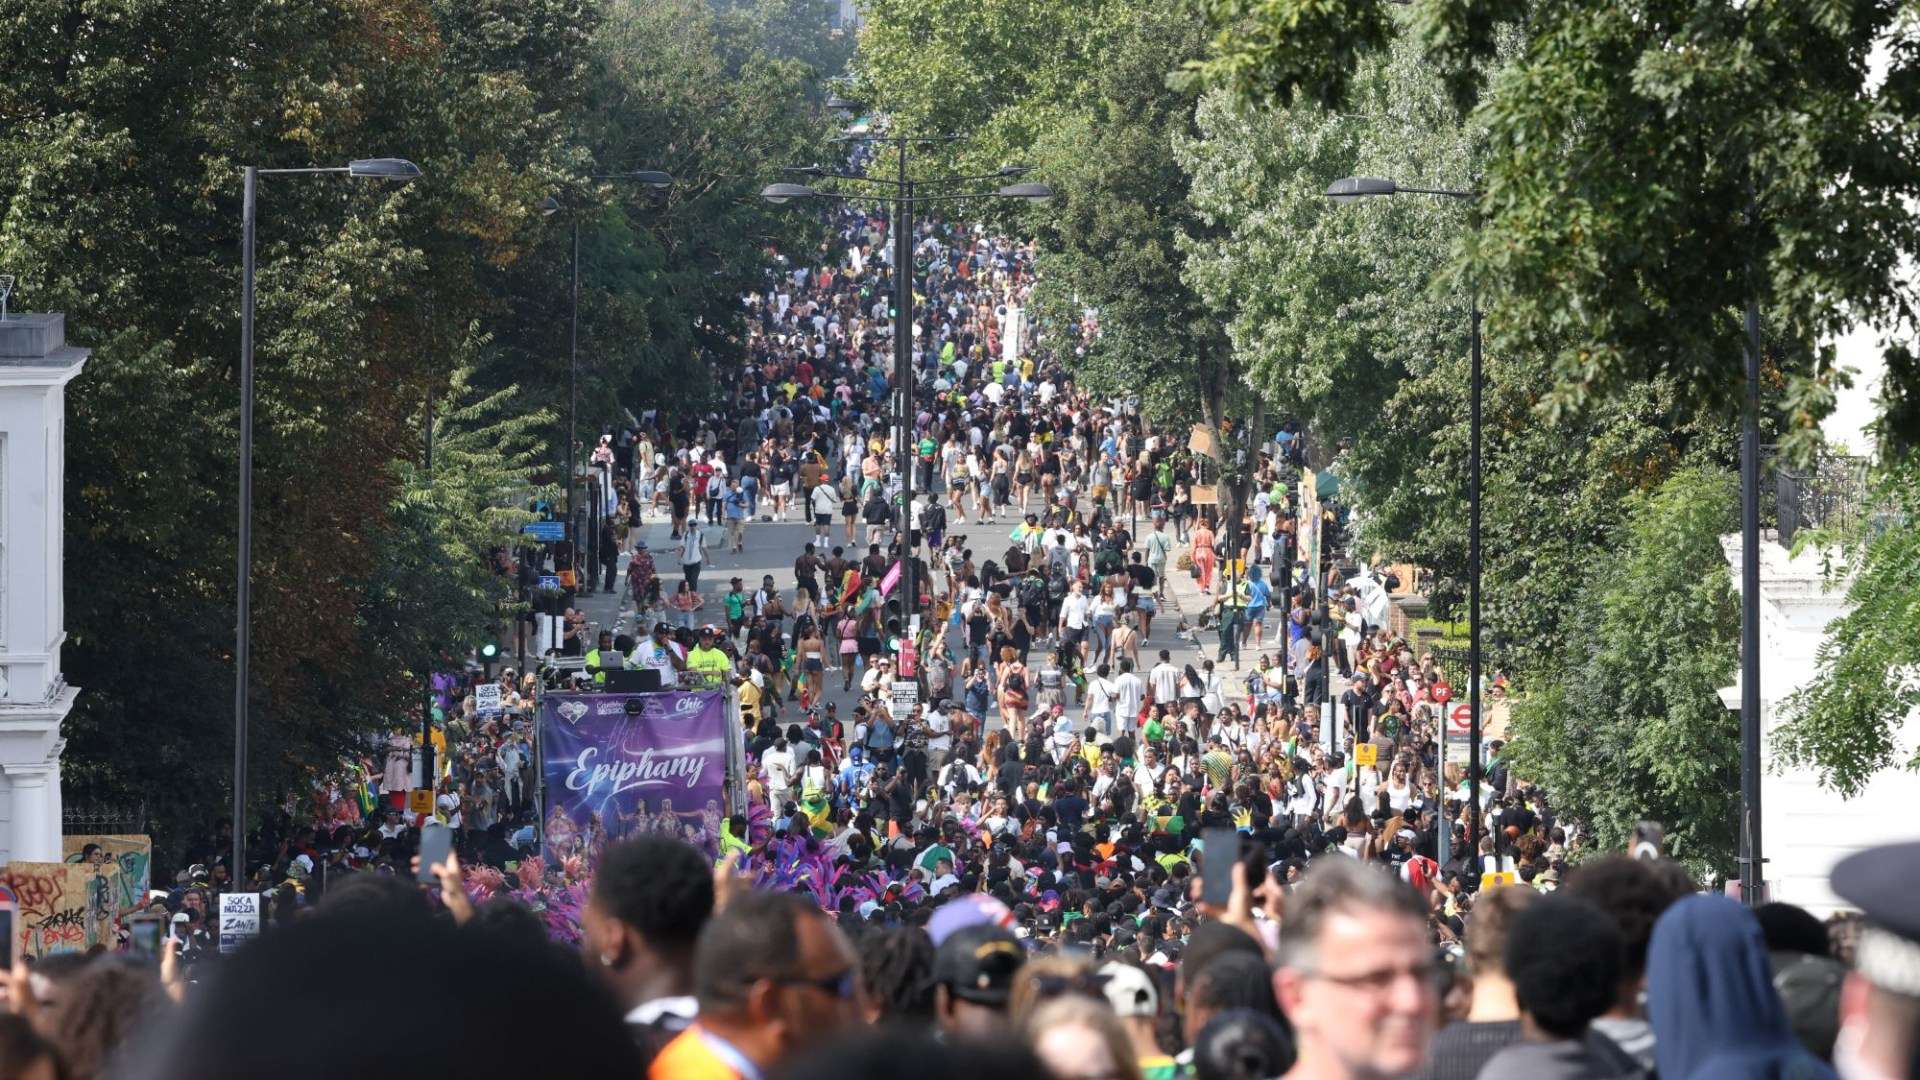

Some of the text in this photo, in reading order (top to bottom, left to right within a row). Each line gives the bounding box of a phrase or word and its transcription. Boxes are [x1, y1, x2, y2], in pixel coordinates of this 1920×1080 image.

[1436, 687, 1448, 696] PF
[675, 696, 704, 713] Chic
[565, 746, 708, 797] Epiphany
[227, 896, 252, 905] SOCA
[223, 905, 256, 914] MAZZA
